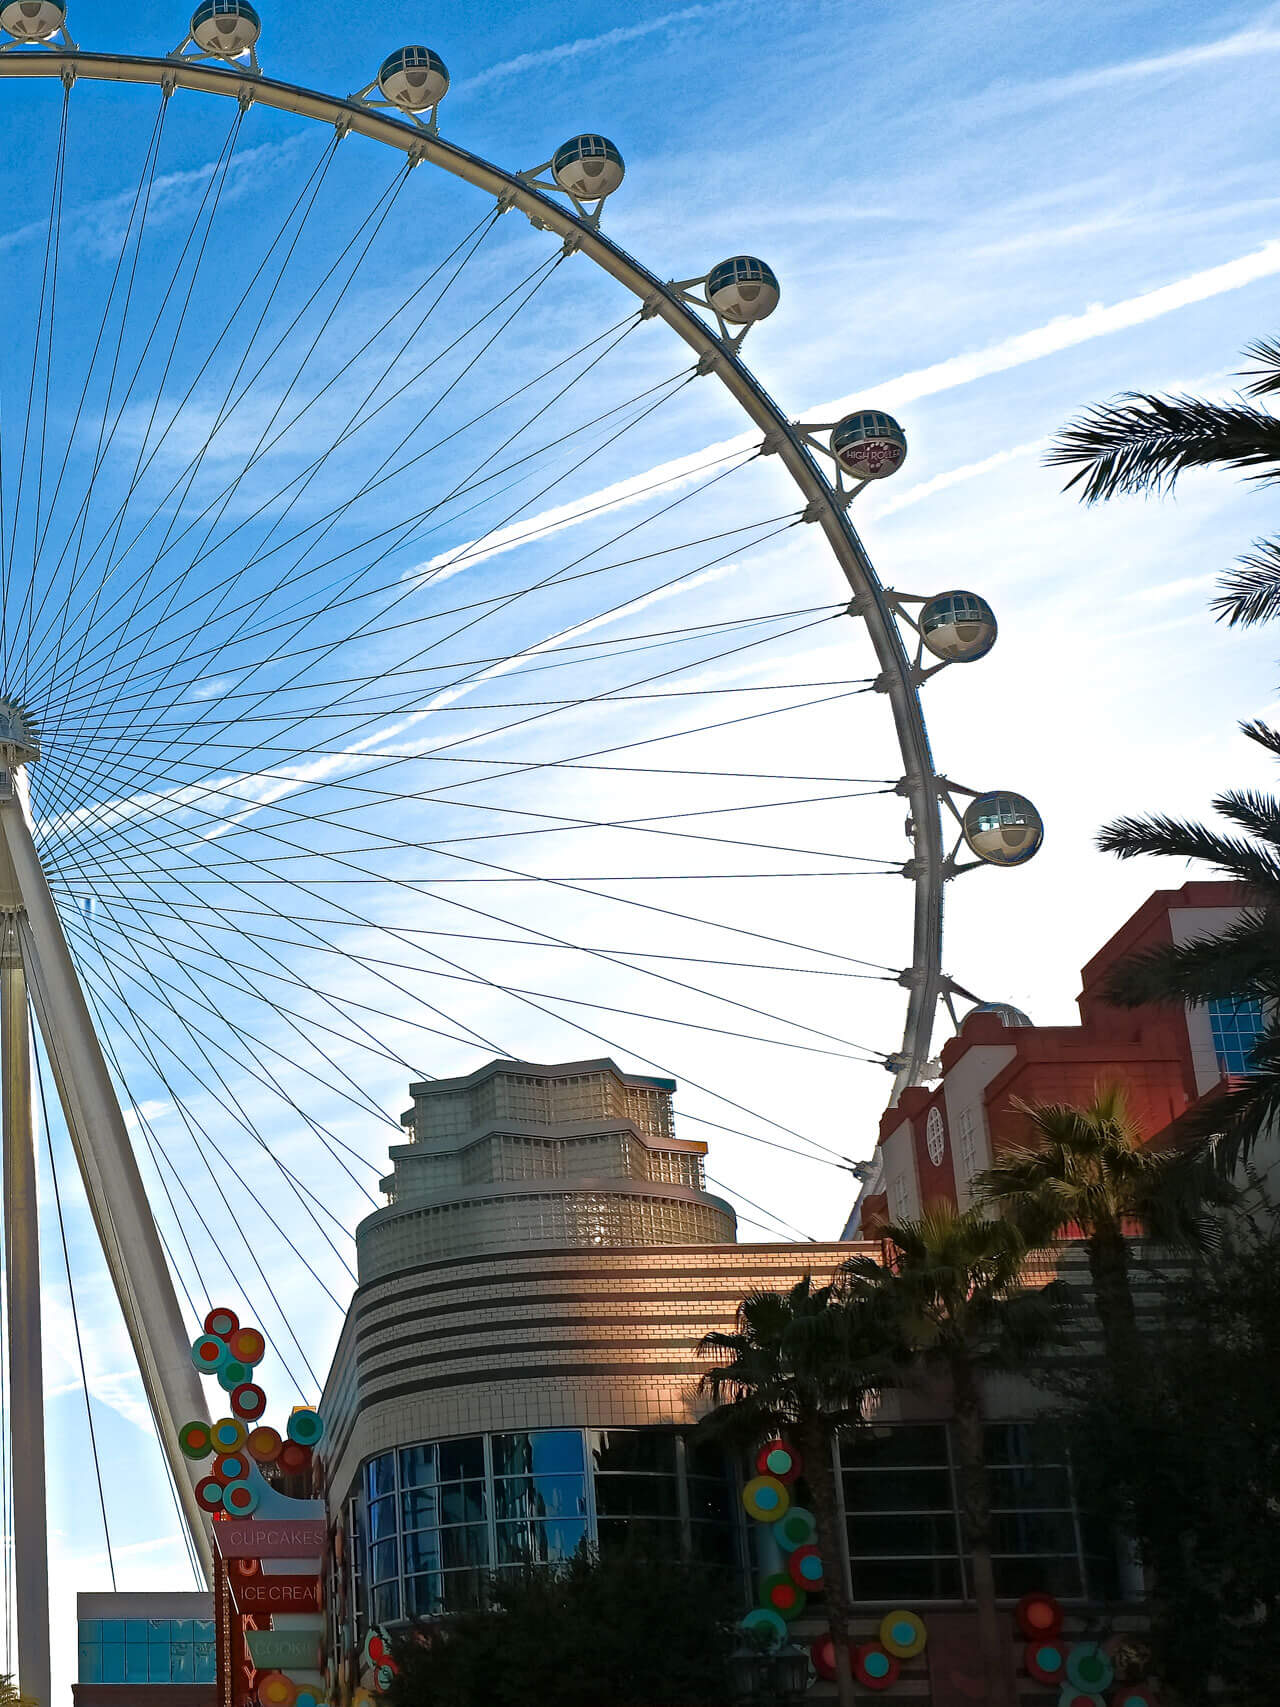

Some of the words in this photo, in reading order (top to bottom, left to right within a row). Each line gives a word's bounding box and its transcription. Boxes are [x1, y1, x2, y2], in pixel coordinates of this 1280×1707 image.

[846, 450, 869, 460] HIGH
[230, 1530, 324, 1545] CUPCAKES
[241, 1586, 266, 1600] ICE
